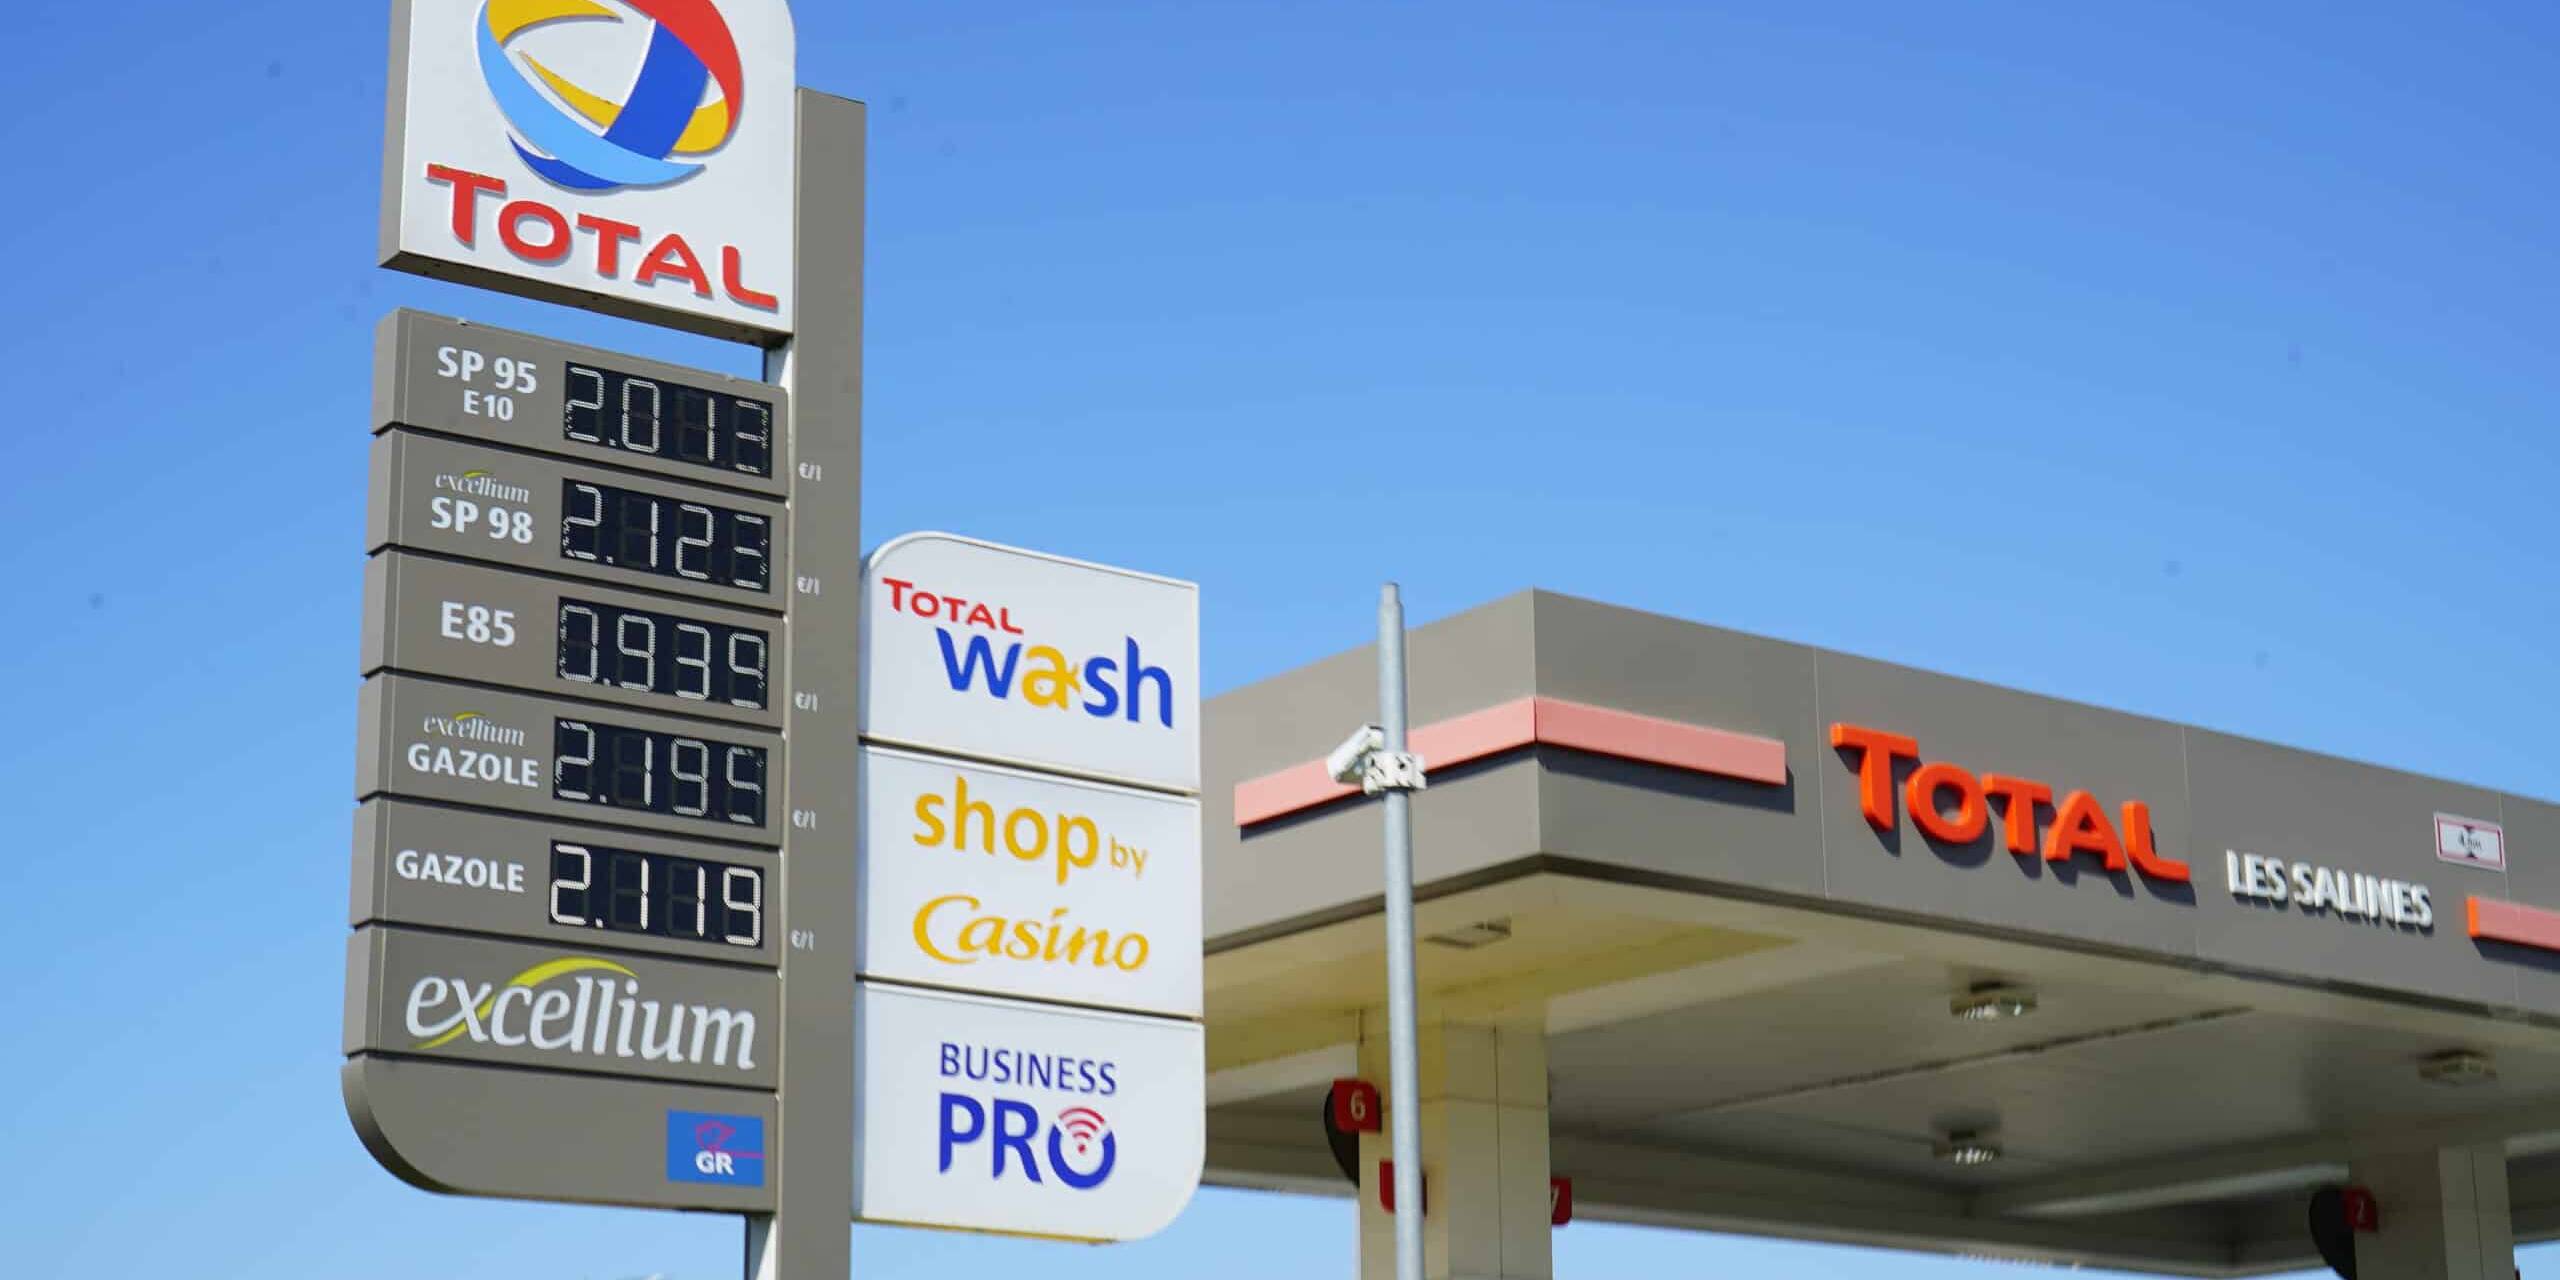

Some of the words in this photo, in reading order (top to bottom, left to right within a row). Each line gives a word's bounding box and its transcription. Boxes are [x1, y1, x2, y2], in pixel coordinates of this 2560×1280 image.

[426, 162, 778, 310] TOTAL
[437, 346, 485, 382] SP
[494, 356, 538, 394] 95
[566, 366, 770, 475] 2.013
[431, 496, 479, 533] SP
[488, 506, 534, 544] 98
[434, 474, 530, 504] excellium
[562, 483, 770, 590] 2.123
[441, 600, 516, 647] E85
[882, 577, 1024, 634] TOTAL
[936, 626, 1173, 729] wash
[423, 715, 526, 747] excellium
[407, 742, 540, 788] GAZOLE
[913, 775, 1100, 884] shop
[1109, 836, 1148, 877] by
[1830, 723, 2191, 883] TOTAL
[395, 850, 525, 893] GAZOLE
[551, 843, 762, 947] 2.119
[2226, 849, 2288, 901] LES
[2291, 862, 2434, 928] SALINES
[912, 894, 1150, 971] Casino
[405, 974, 757, 1071] excellium
[939, 1042, 1117, 1096] BUSINESS
[1350, 1089, 1366, 1122] 6
[695, 1150, 736, 1176] GR
[938, 1092, 1117, 1190] PRO
